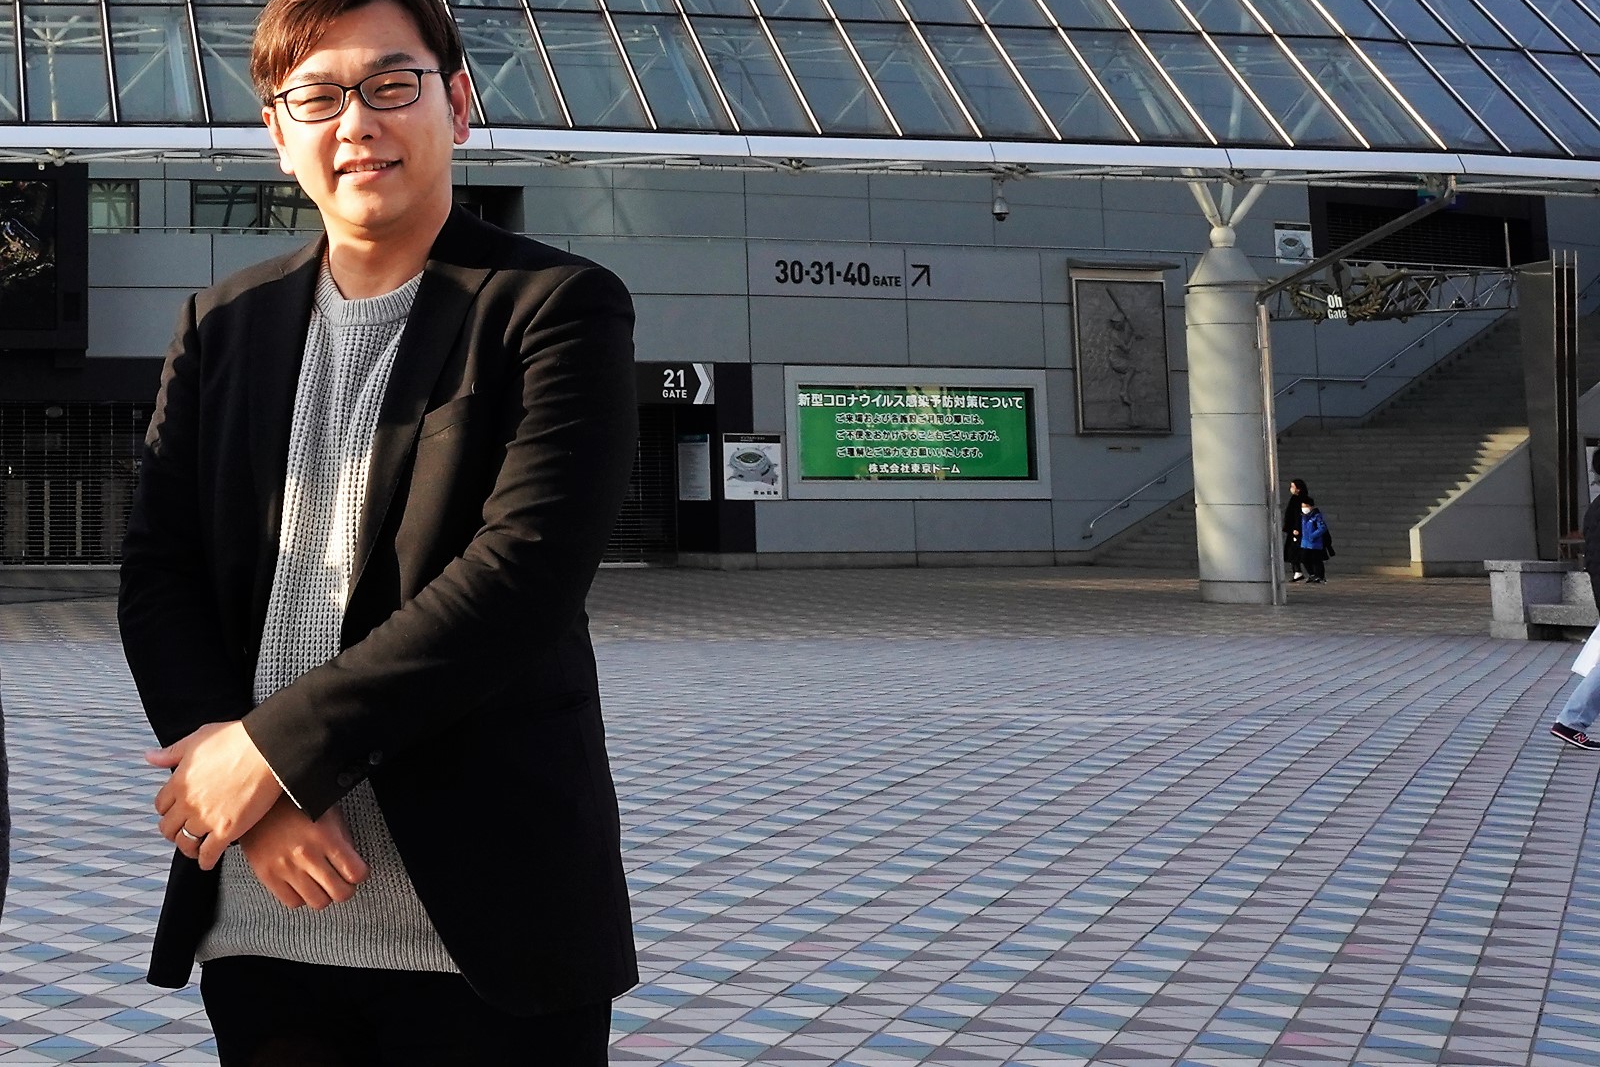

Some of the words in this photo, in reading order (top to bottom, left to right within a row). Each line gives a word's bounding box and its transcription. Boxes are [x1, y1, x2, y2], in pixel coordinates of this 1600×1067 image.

[872, 275, 901, 287] GATE
[1327, 294, 1343, 308] Oh
[1327, 309, 1347, 319] Gate
[663, 369, 685, 387] 21
[662, 389, 688, 398] GATE
[798, 393, 1023, 408] 新型コロナウイルス感染予防対策について
[868, 463, 960, 474] 株式会社東京ドーム
